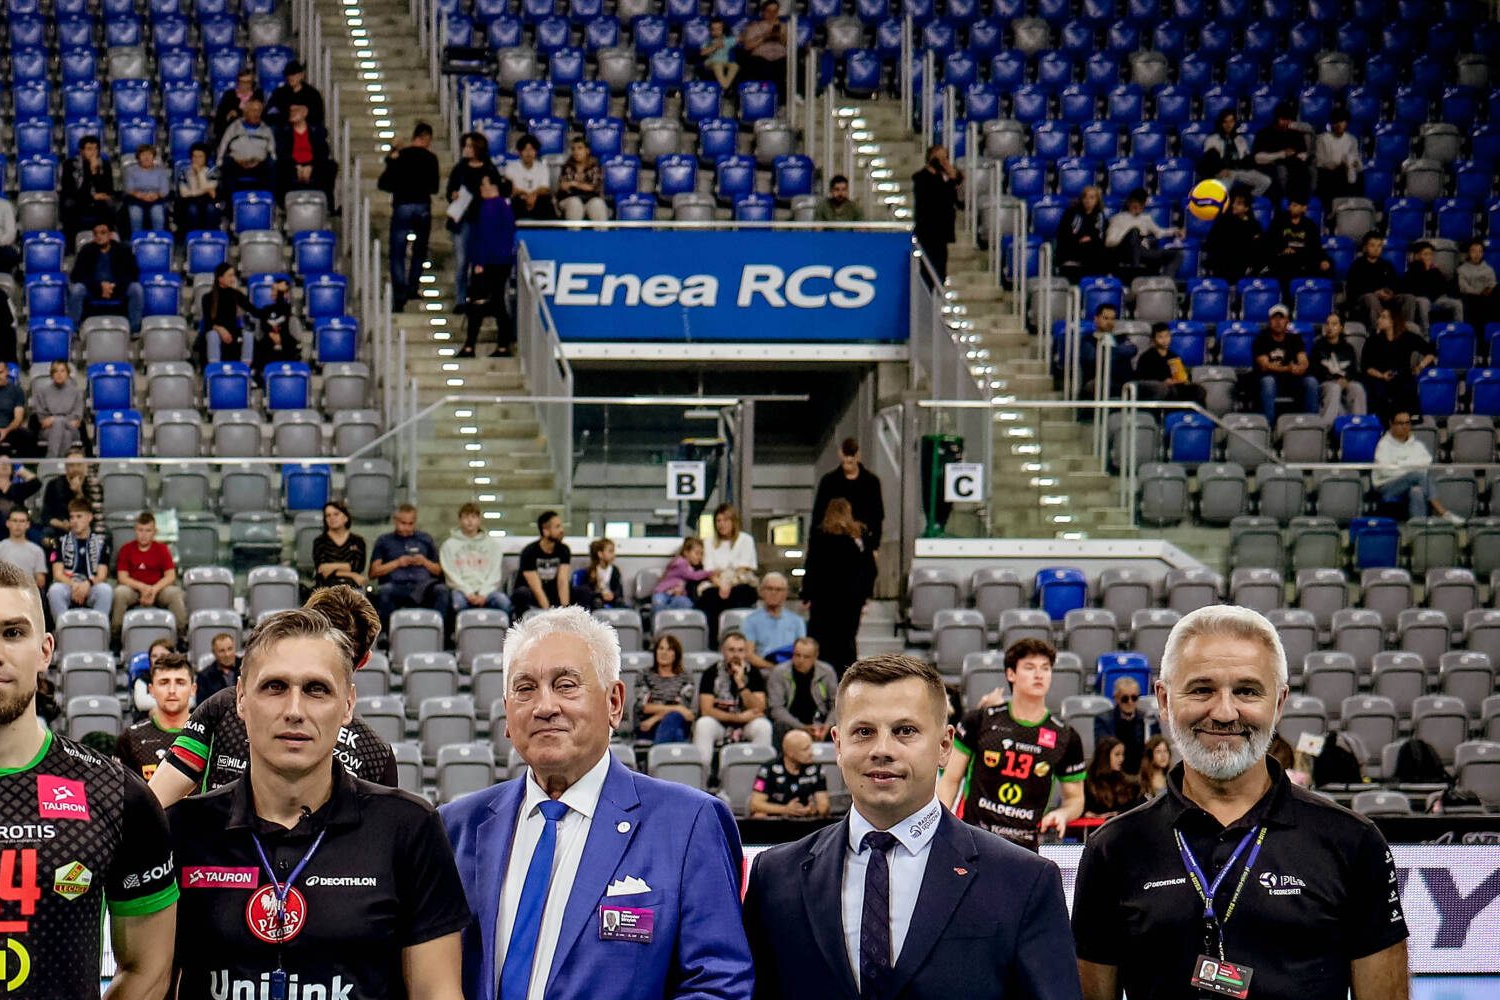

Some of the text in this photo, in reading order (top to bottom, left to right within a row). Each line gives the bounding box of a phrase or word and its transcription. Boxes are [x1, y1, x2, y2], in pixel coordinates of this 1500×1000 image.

[554, 263, 878, 309] Enea RCS
[676, 474, 696, 496] B
[953, 476, 974, 497] C
[337, 726, 360, 749] EK
[1000, 750, 1034, 779] 13
[42, 801, 86, 813] TAURON
[978, 797, 1035, 820] DALDEHOG
[205, 871, 252, 883] TAURON
[320, 876, 377, 887] DECATHLON
